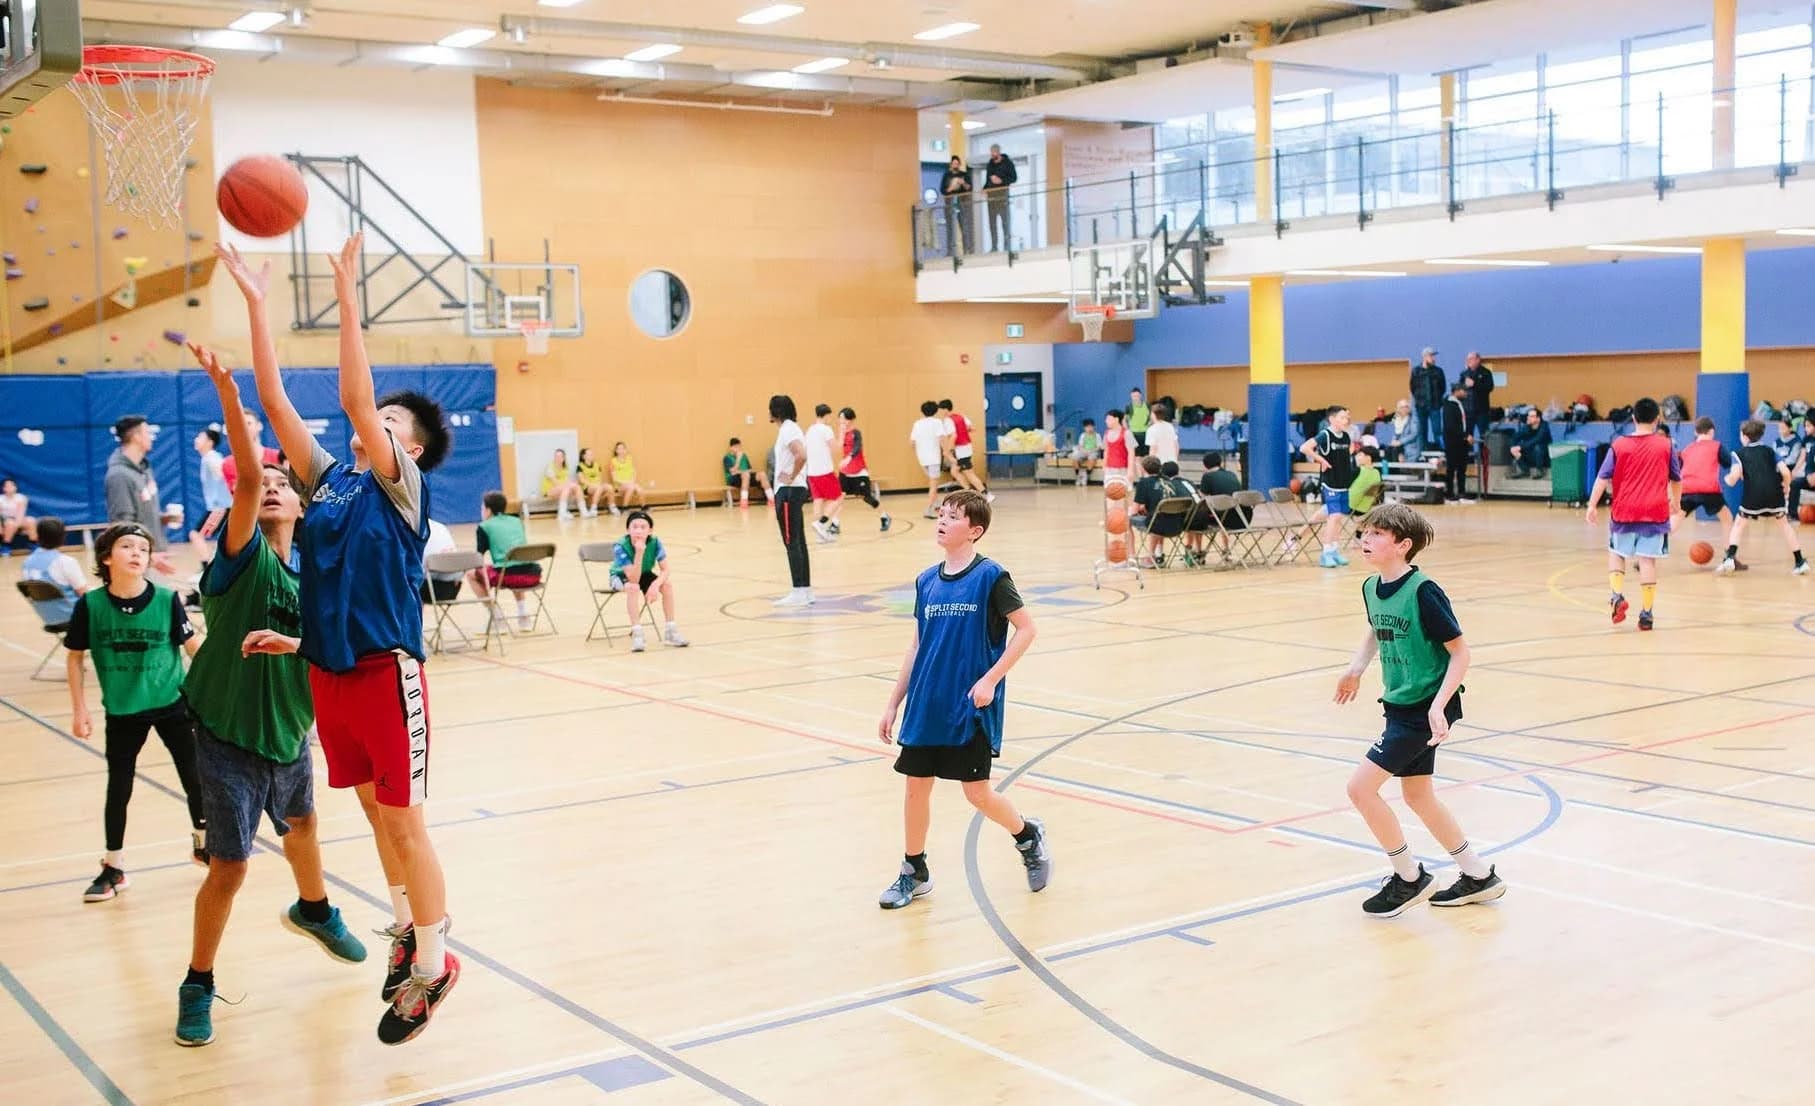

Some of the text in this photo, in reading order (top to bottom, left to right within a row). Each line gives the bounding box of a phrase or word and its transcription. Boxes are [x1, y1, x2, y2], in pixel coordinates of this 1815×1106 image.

[930, 603, 977, 612] SPLIT SECOND
[405, 673, 425, 780] JORDAN
